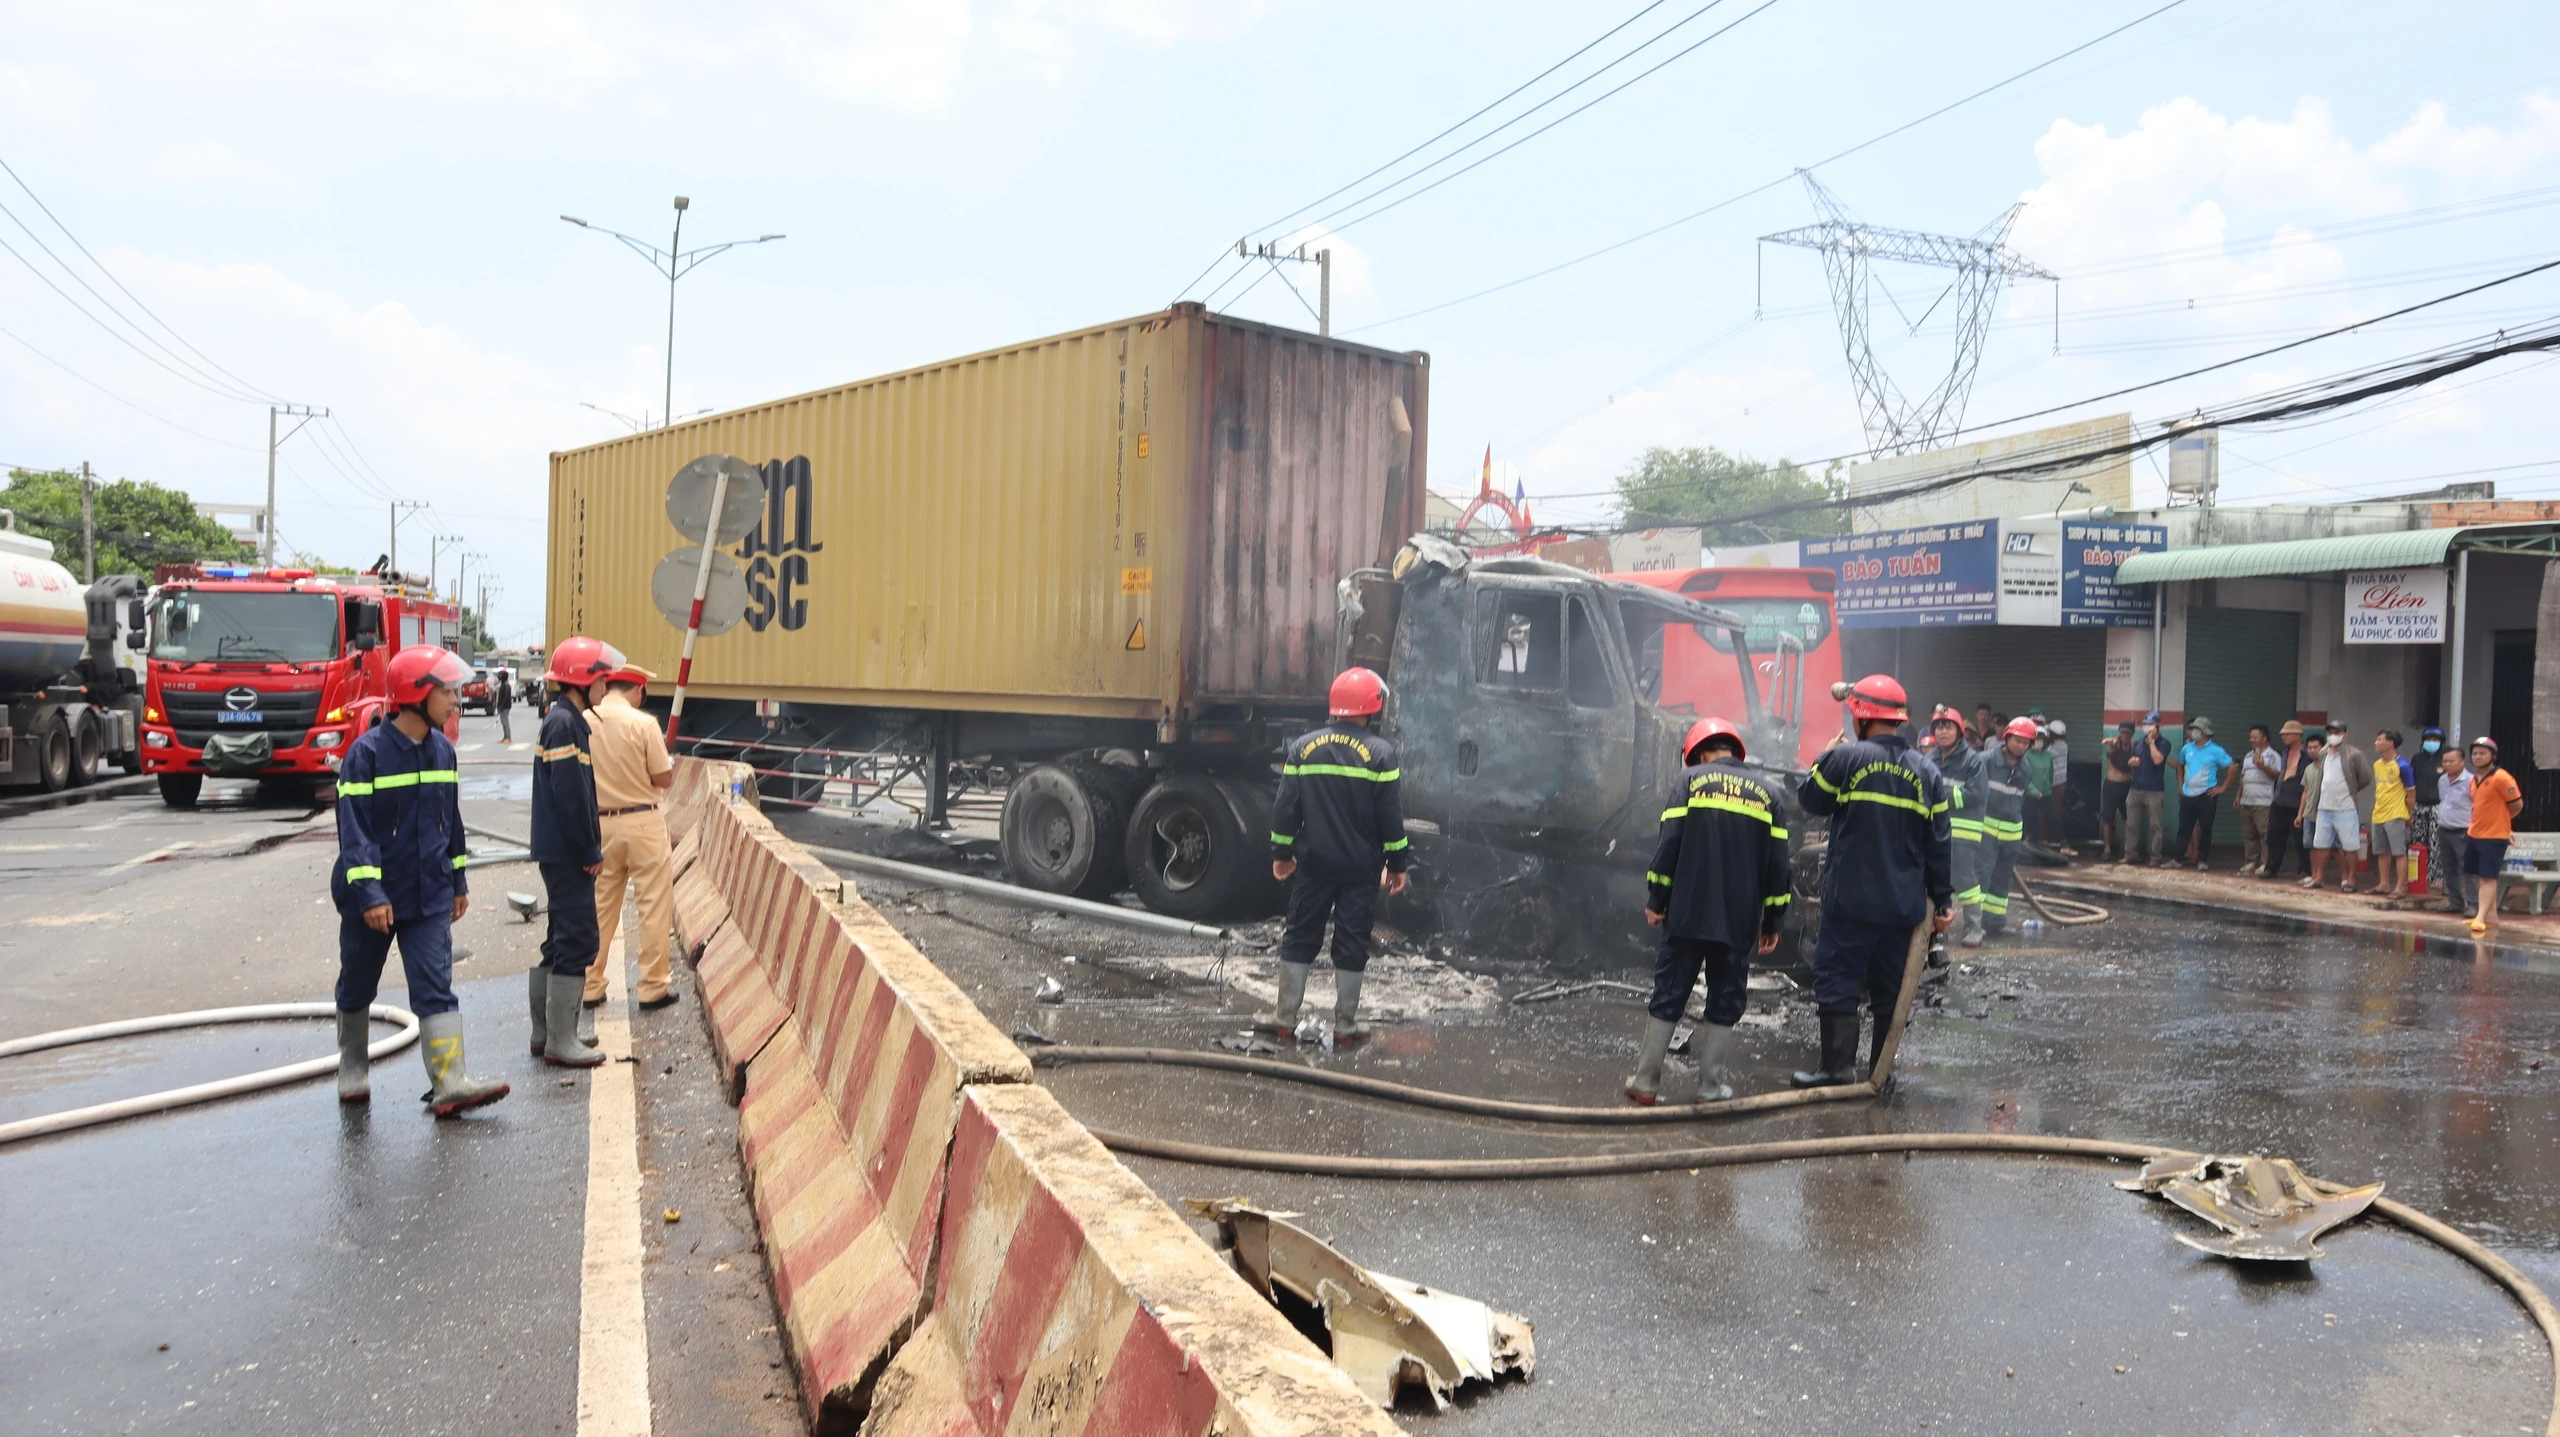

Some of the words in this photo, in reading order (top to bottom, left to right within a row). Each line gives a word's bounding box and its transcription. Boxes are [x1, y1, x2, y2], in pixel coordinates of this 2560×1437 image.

[1949, 527, 1962, 541] XE
[2067, 526, 2086, 541] SHOP
[2152, 531, 2163, 545] XE
[2084, 545, 2113, 566] BẢO
[1843, 554, 1883, 582] BẢO
[1887, 547, 1942, 577] TUẤN
[2351, 571, 2376, 586] NHÀ
[2379, 572, 2407, 585] MAY
[2357, 584, 2429, 611] Liên
[2387, 614, 2438, 626] VESTON
[2366, 627, 2393, 641] PHỤC
[1723, 782, 1741, 796] 114
